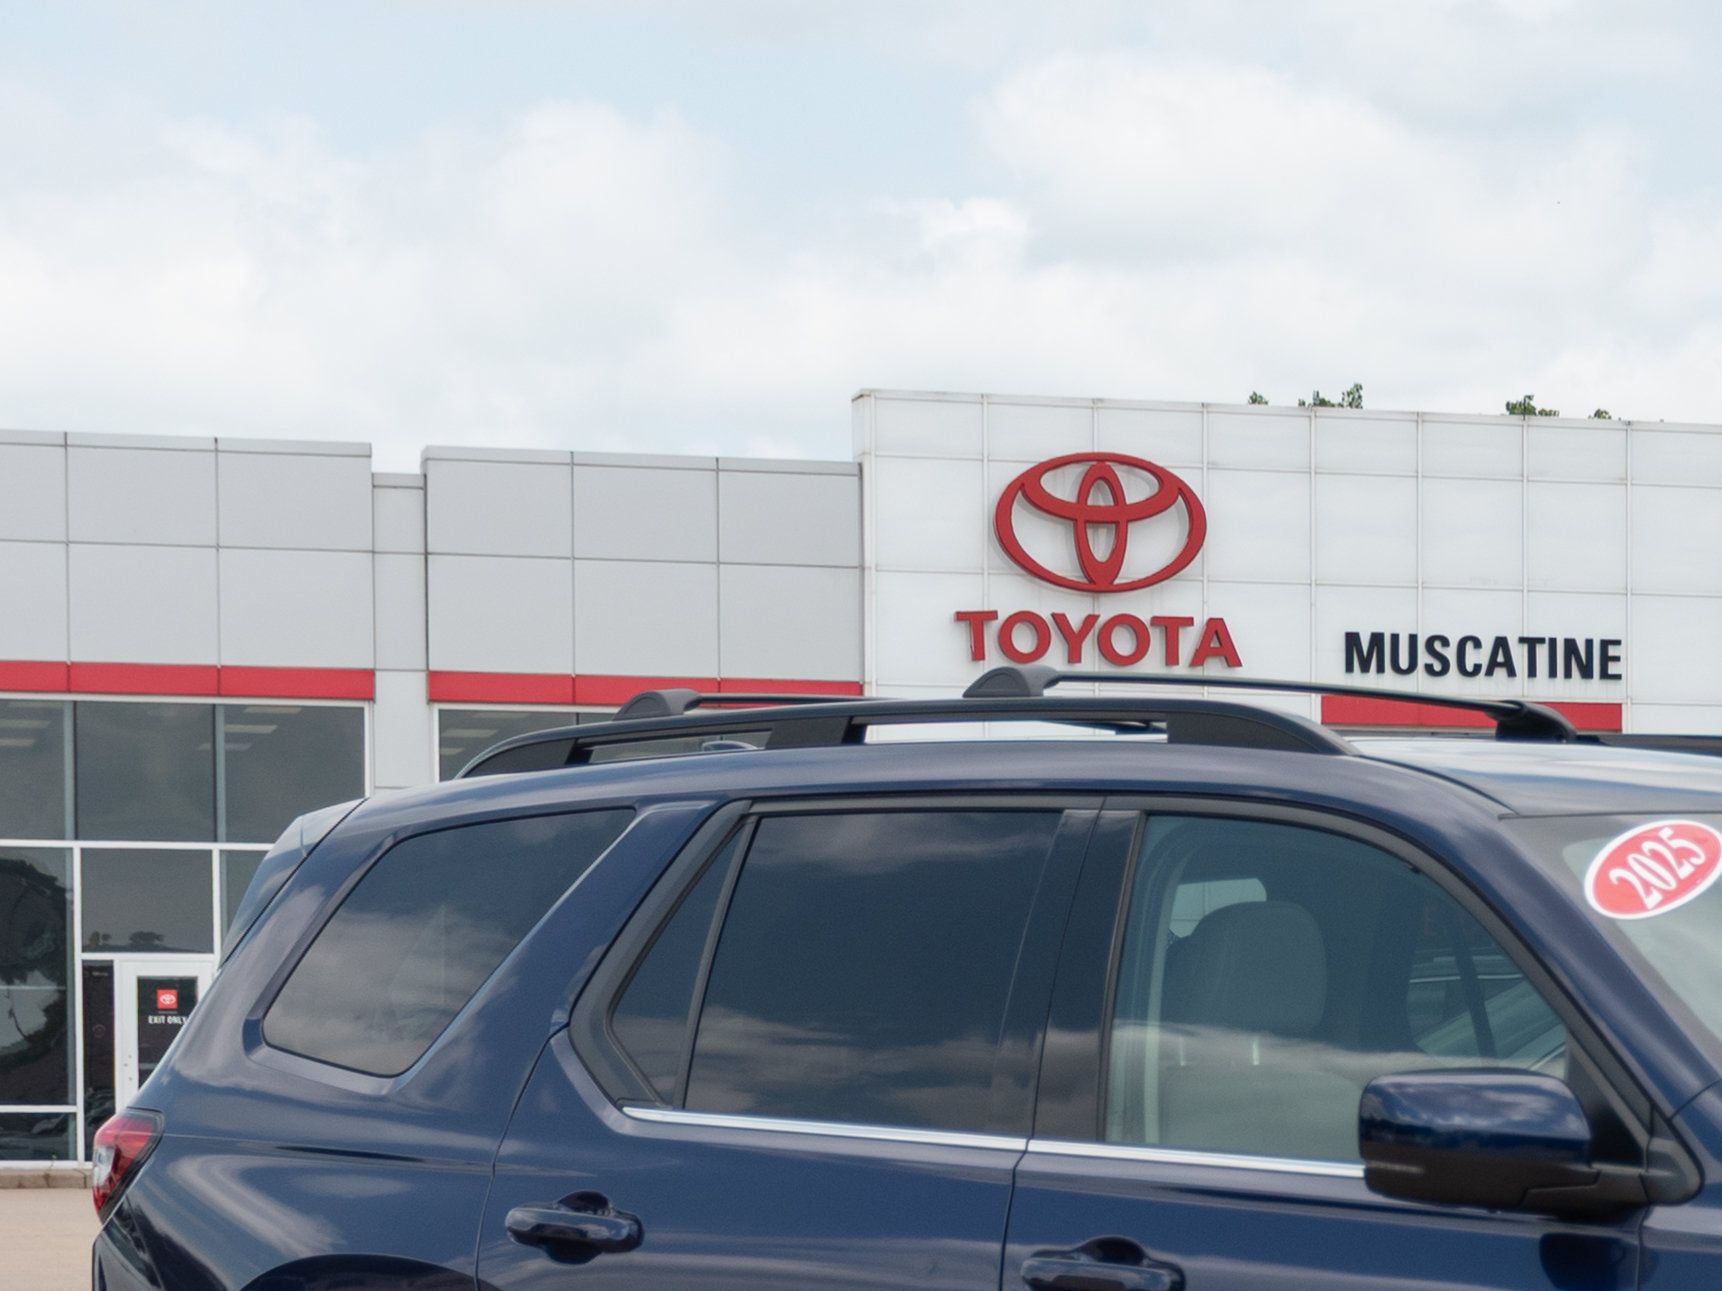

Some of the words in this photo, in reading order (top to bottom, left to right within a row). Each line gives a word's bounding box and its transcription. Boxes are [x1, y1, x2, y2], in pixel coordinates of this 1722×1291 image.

[955, 609, 1243, 668] TOYOTA
[1344, 631, 1623, 681] MUSCATINE
[1608, 826, 1706, 909] 2025
[148, 1015, 165, 1024] EXIT
[167, 1015, 187, 1025] ONLY
